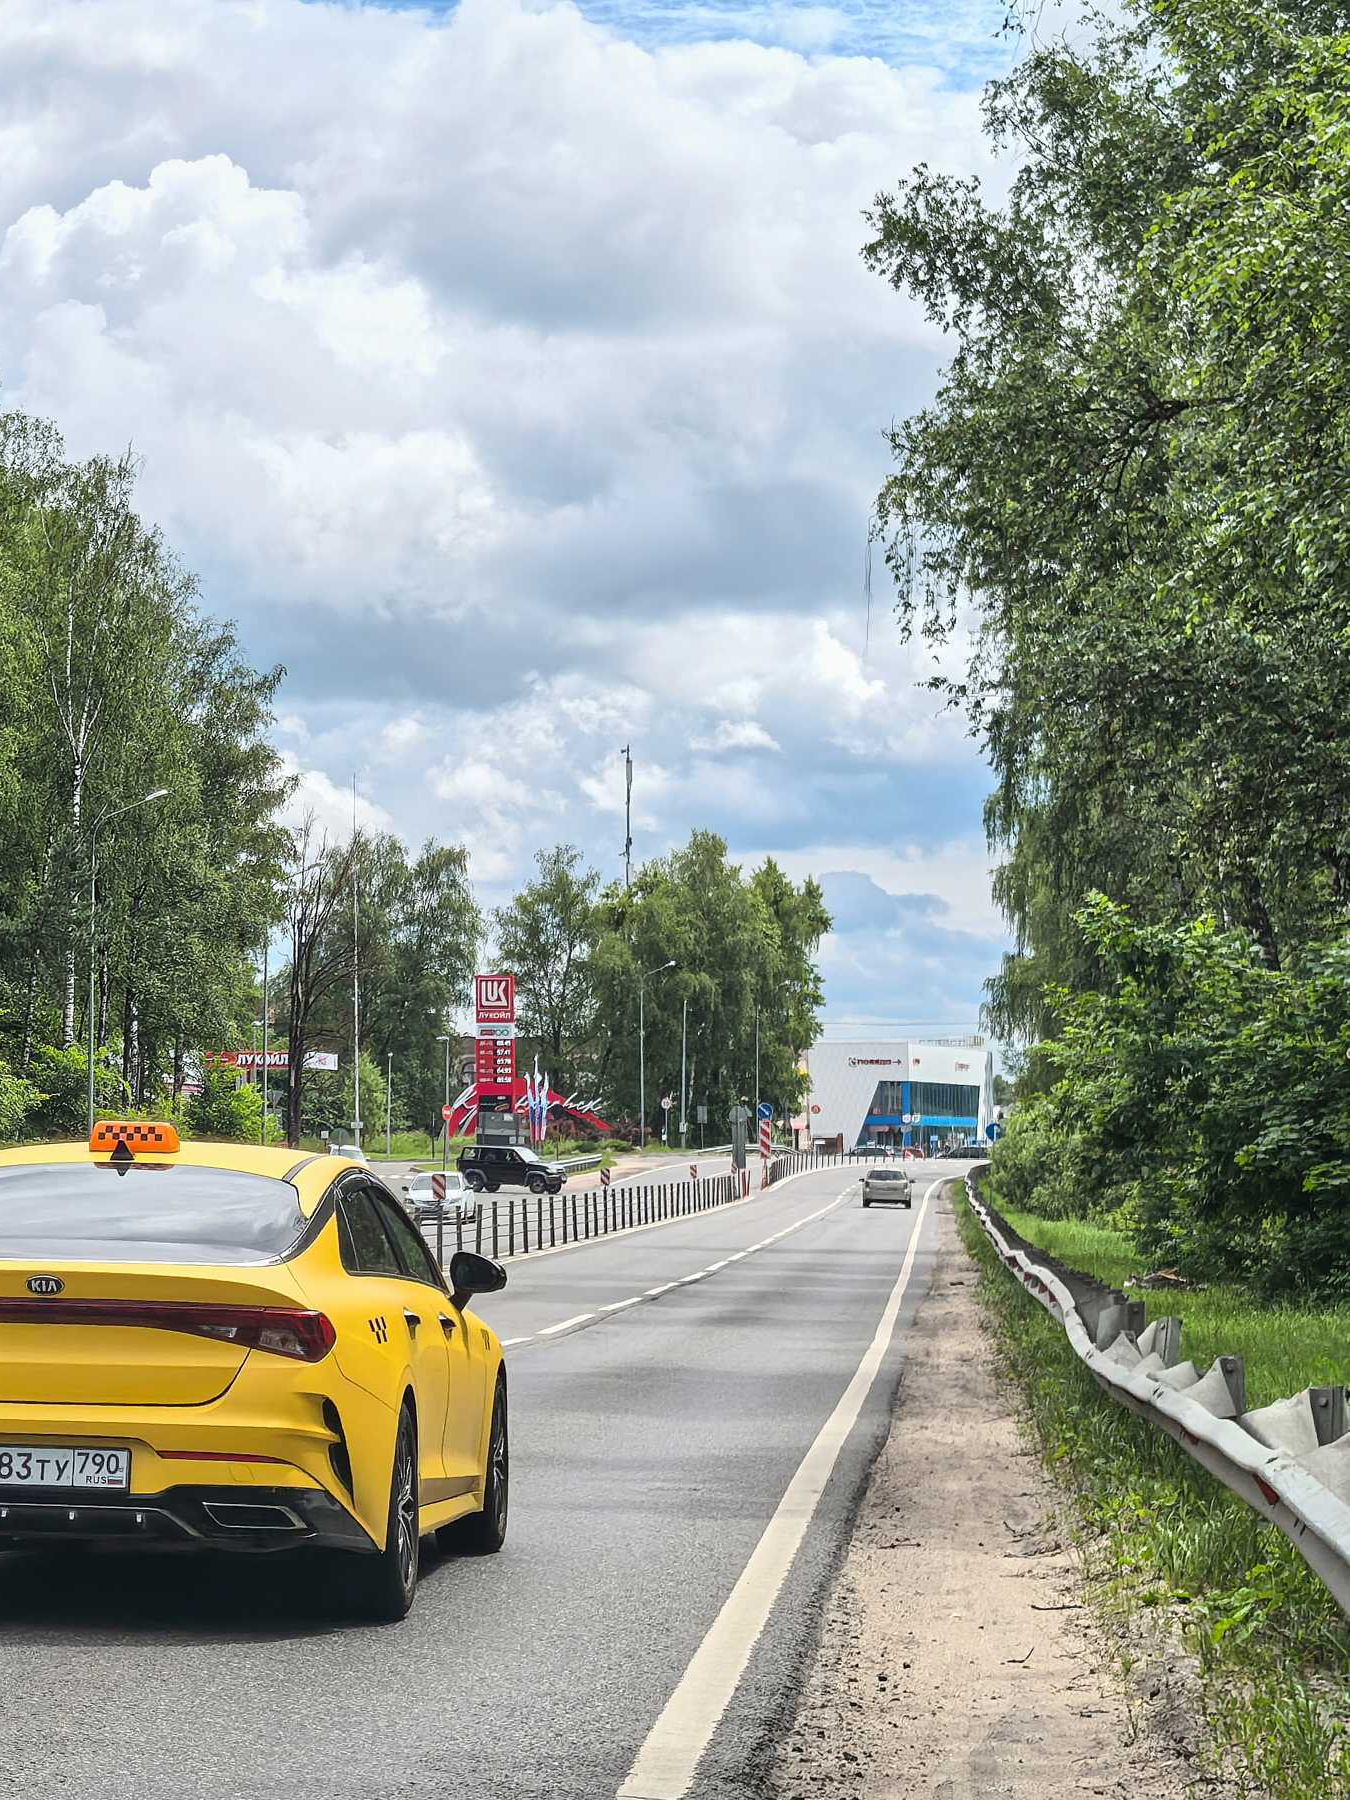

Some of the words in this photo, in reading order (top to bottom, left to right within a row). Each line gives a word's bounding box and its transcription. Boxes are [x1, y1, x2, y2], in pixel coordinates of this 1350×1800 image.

[31, 1280, 57, 1291] KIA
[77, 1452, 120, 1475] 790
[85, 1475, 107, 1485] RUS
